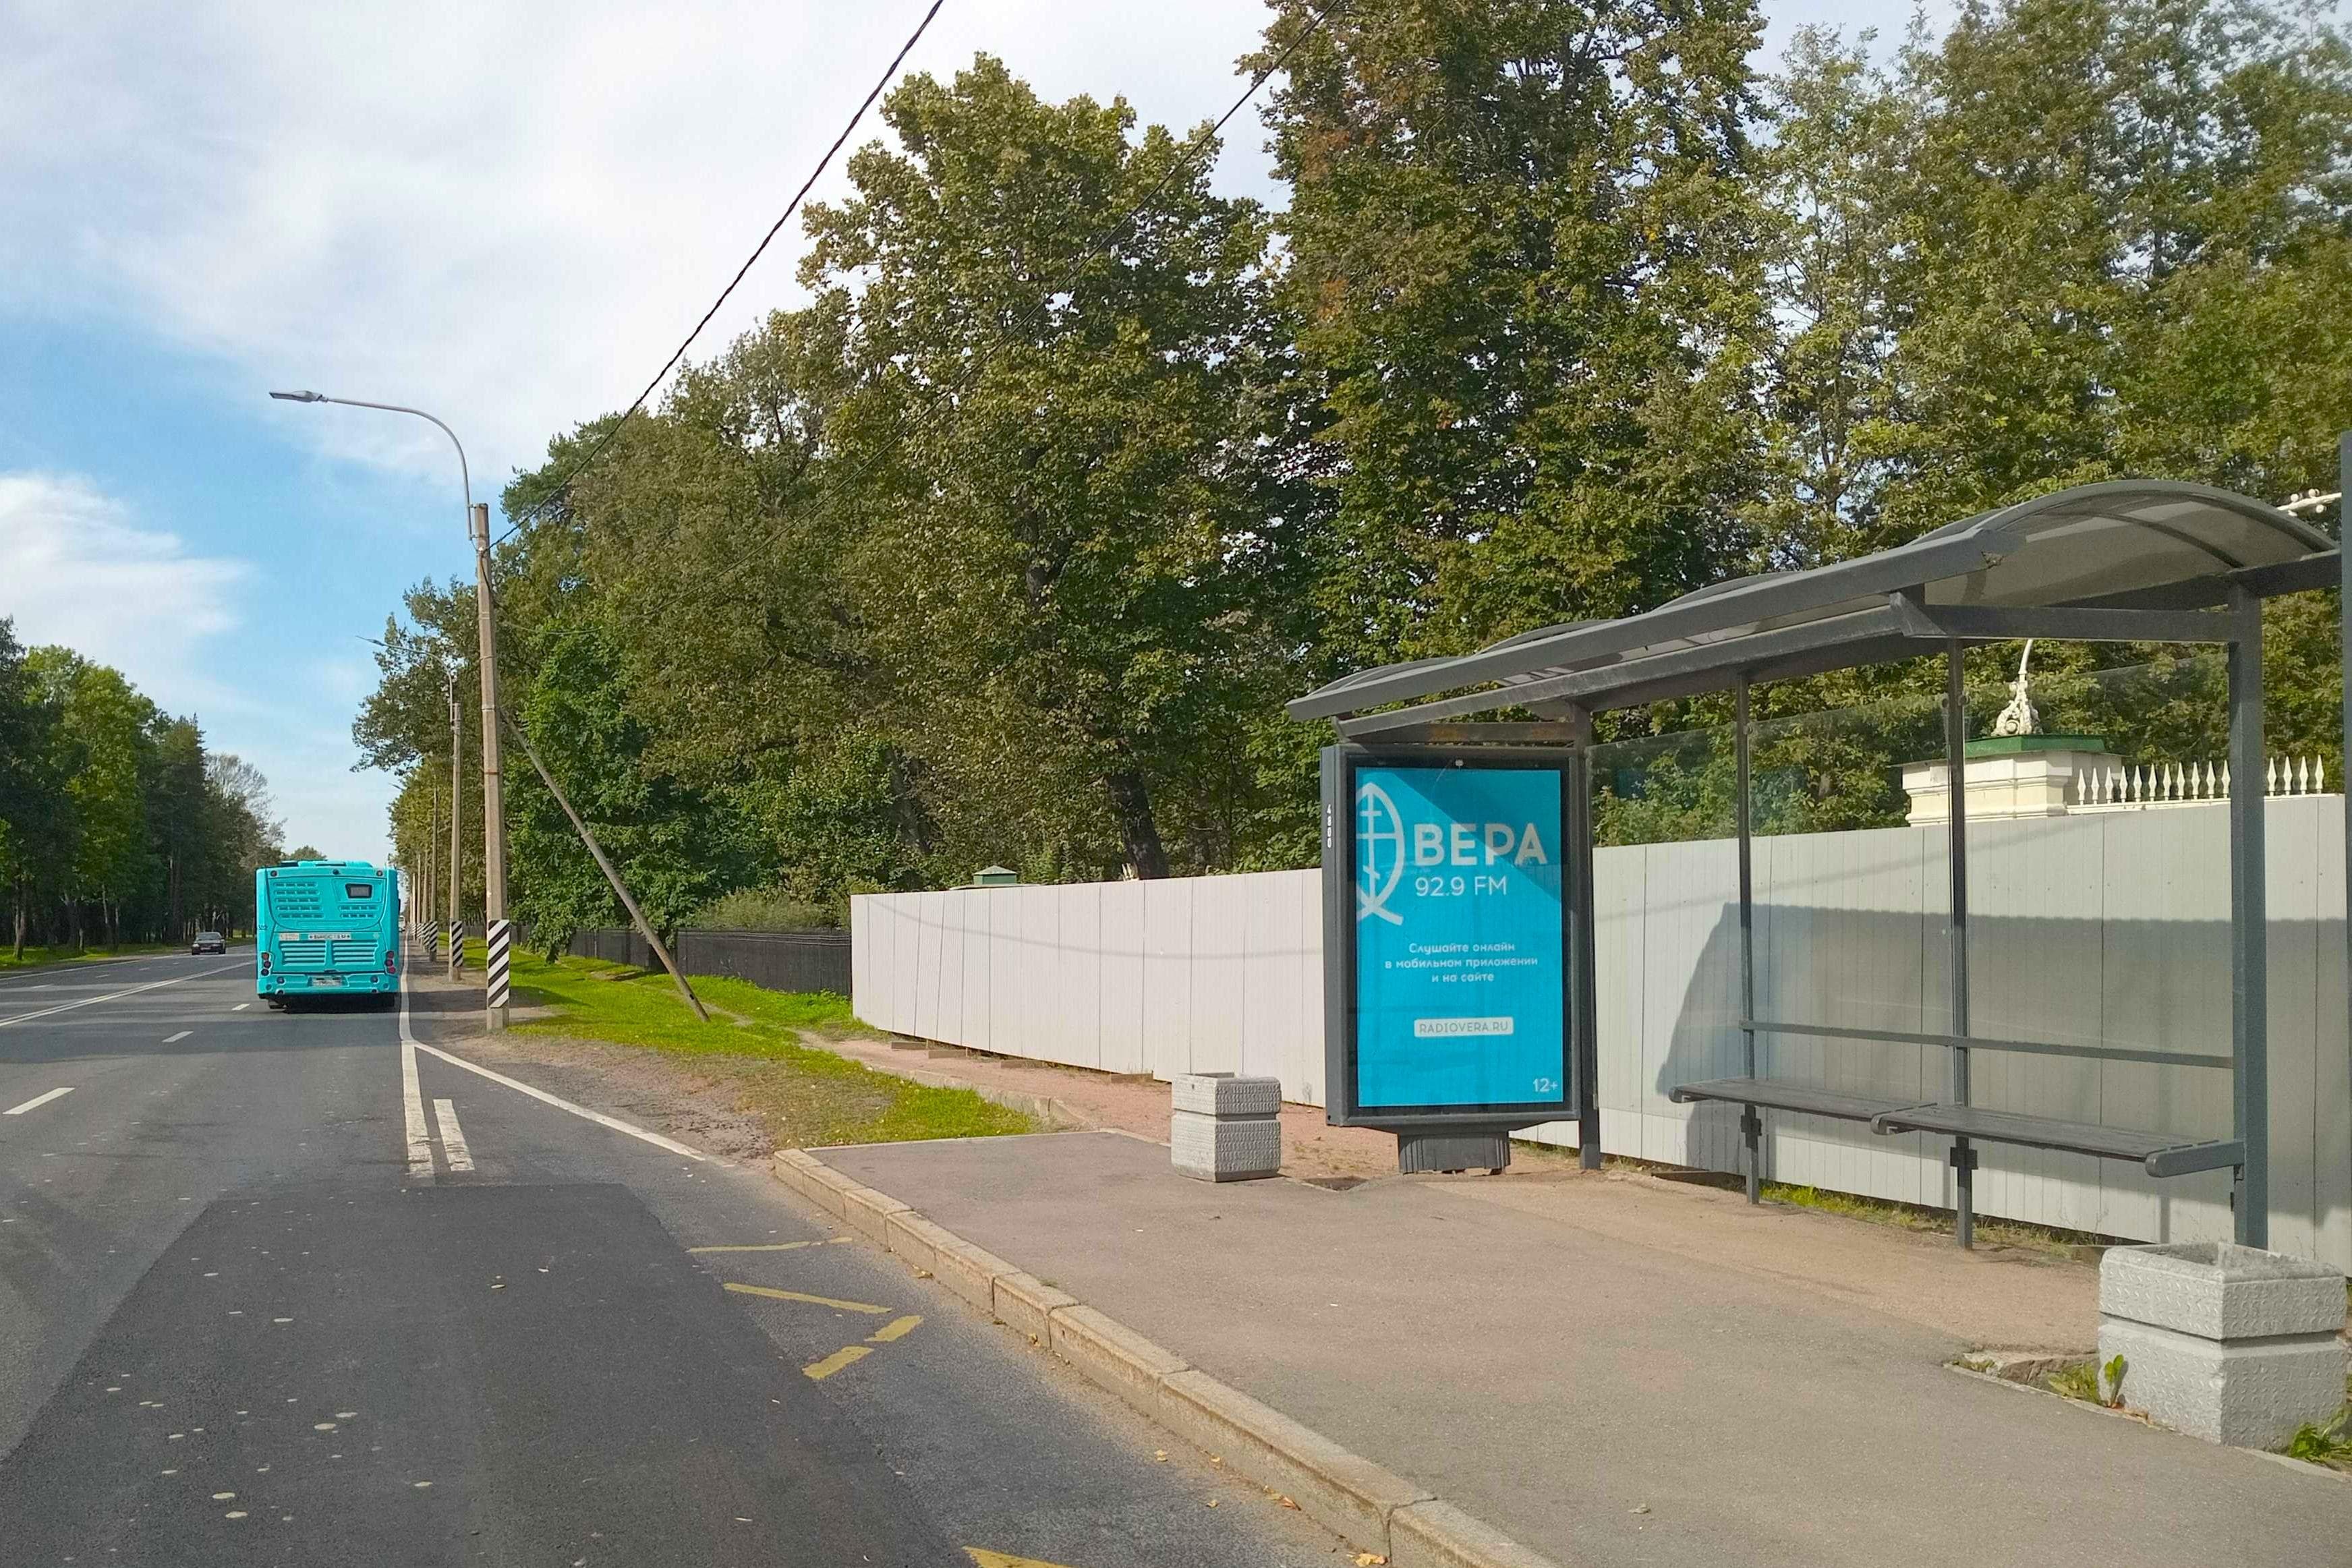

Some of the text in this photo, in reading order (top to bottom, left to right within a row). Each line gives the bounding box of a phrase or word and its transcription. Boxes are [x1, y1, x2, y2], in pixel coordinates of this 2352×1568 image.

[1414, 822, 1548, 866] ВЕРА
[1415, 876, 1507, 897] 92.9 FM
[1409, 942, 1515, 956] Слушайте онлайн
[1385, 957, 1539, 970] в мобильном приложении
[1431, 972, 1495, 983] и на сайте
[1418, 1021, 1509, 1034] RADIOVERA.RU
[1532, 1078, 1559, 1093] 12+
